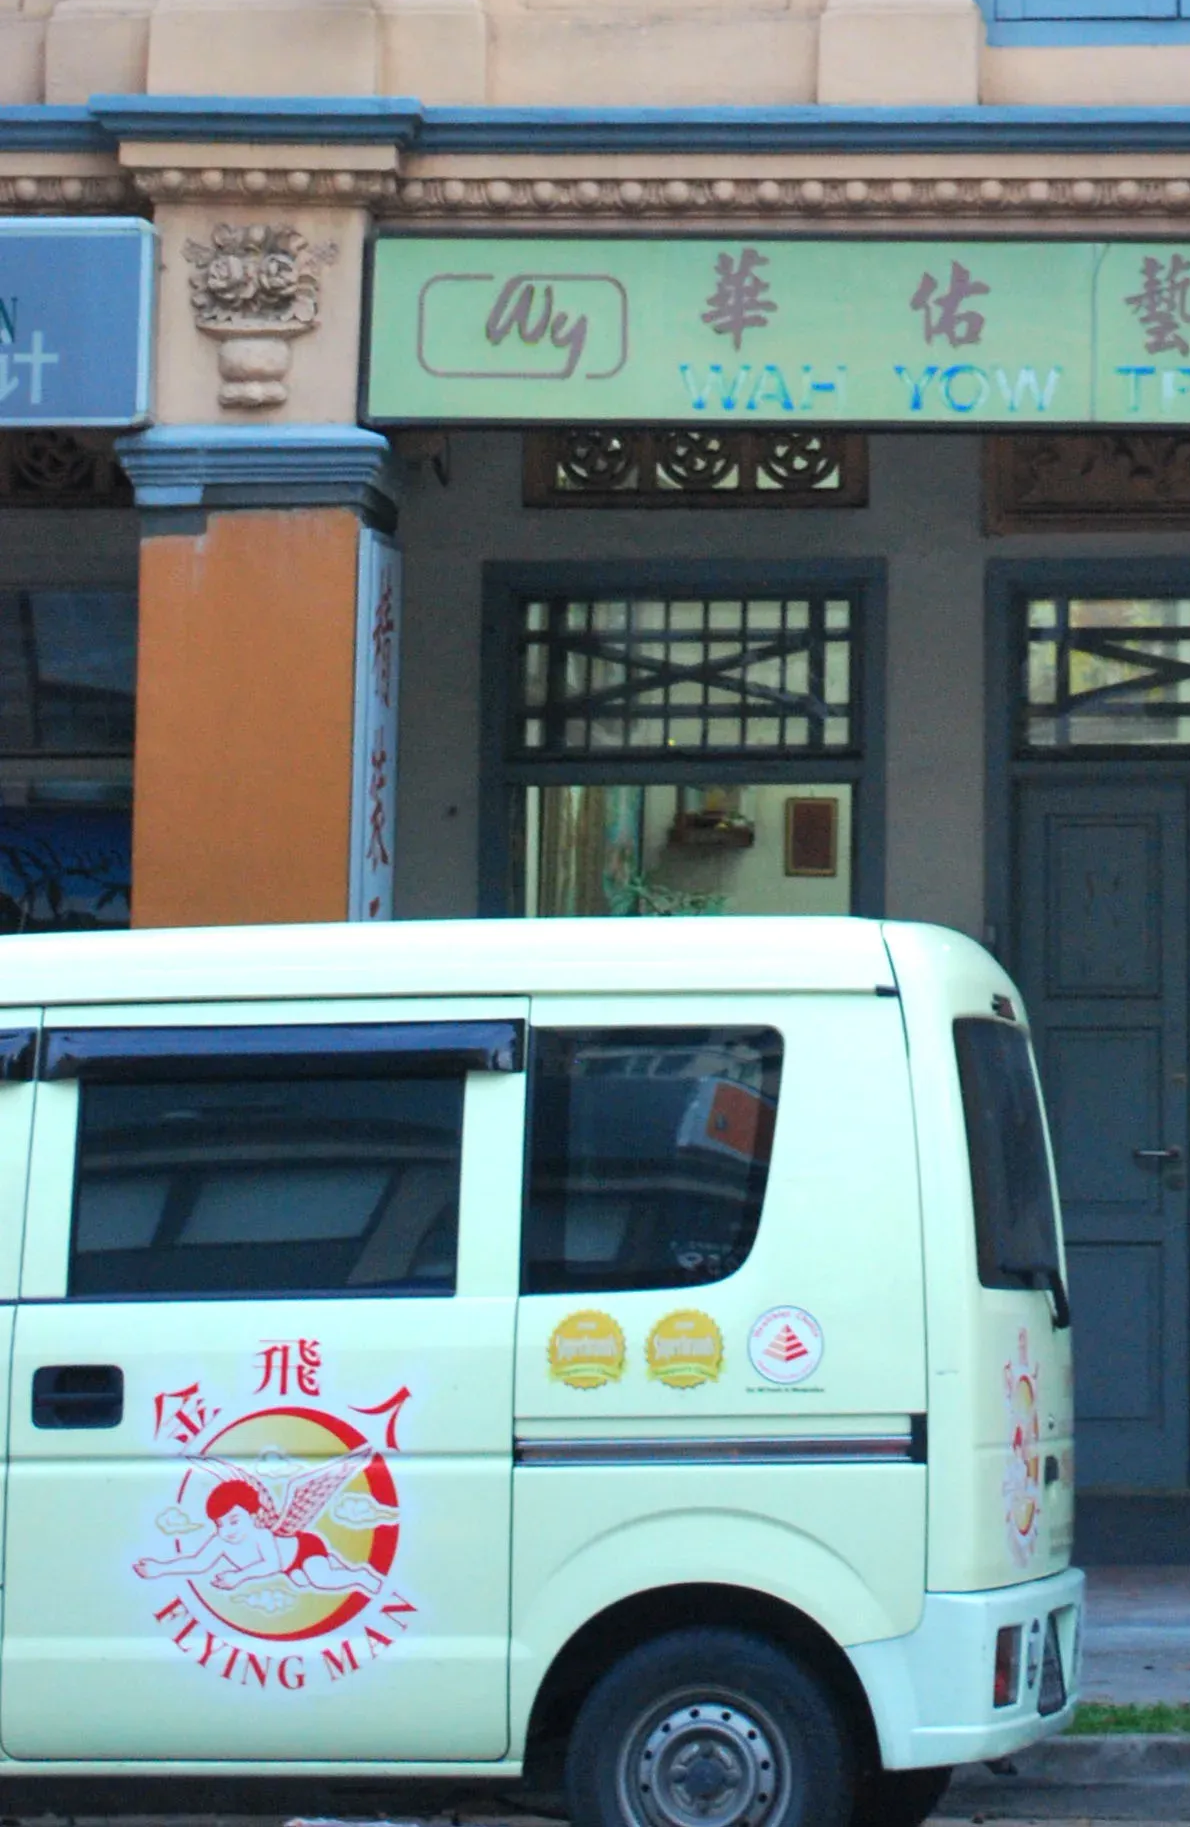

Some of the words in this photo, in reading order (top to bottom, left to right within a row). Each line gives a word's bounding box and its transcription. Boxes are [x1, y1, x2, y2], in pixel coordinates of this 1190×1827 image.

[678, 363, 847, 412] WAH
[894, 363, 1063, 413] YOW
[154, 1595, 306, 1691] FLYING
[322, 1590, 418, 1682] MAN
